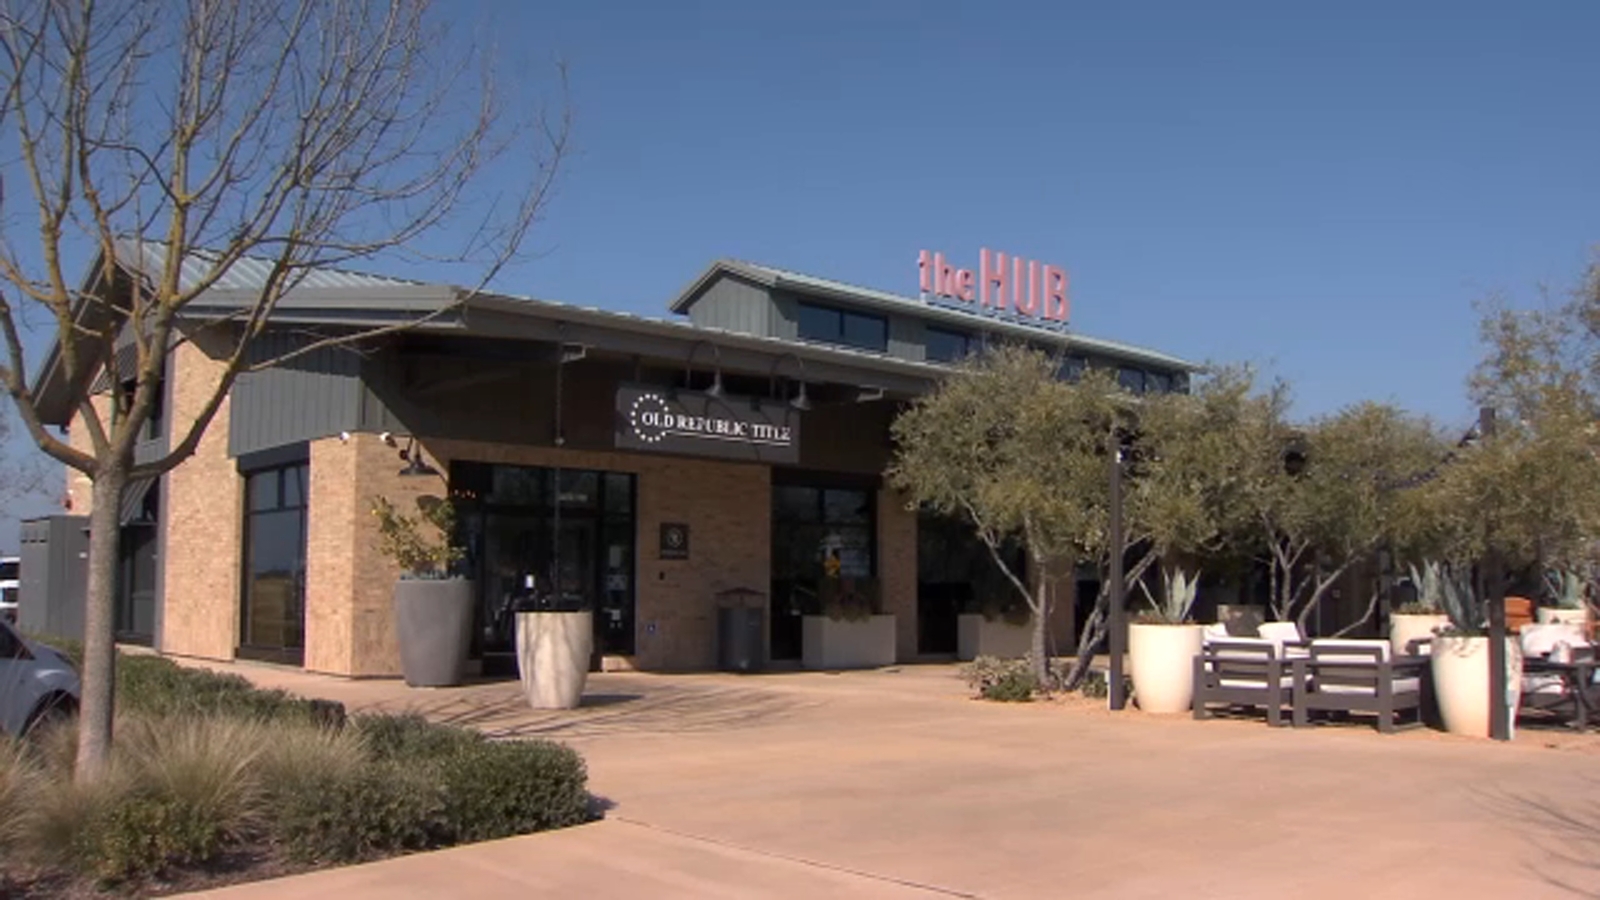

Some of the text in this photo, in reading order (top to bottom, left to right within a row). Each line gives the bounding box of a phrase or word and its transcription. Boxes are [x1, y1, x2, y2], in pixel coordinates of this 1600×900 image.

[917, 247, 1070, 321] the HUB
[641, 411, 791, 440] OLD REPUBLIC TITLE
